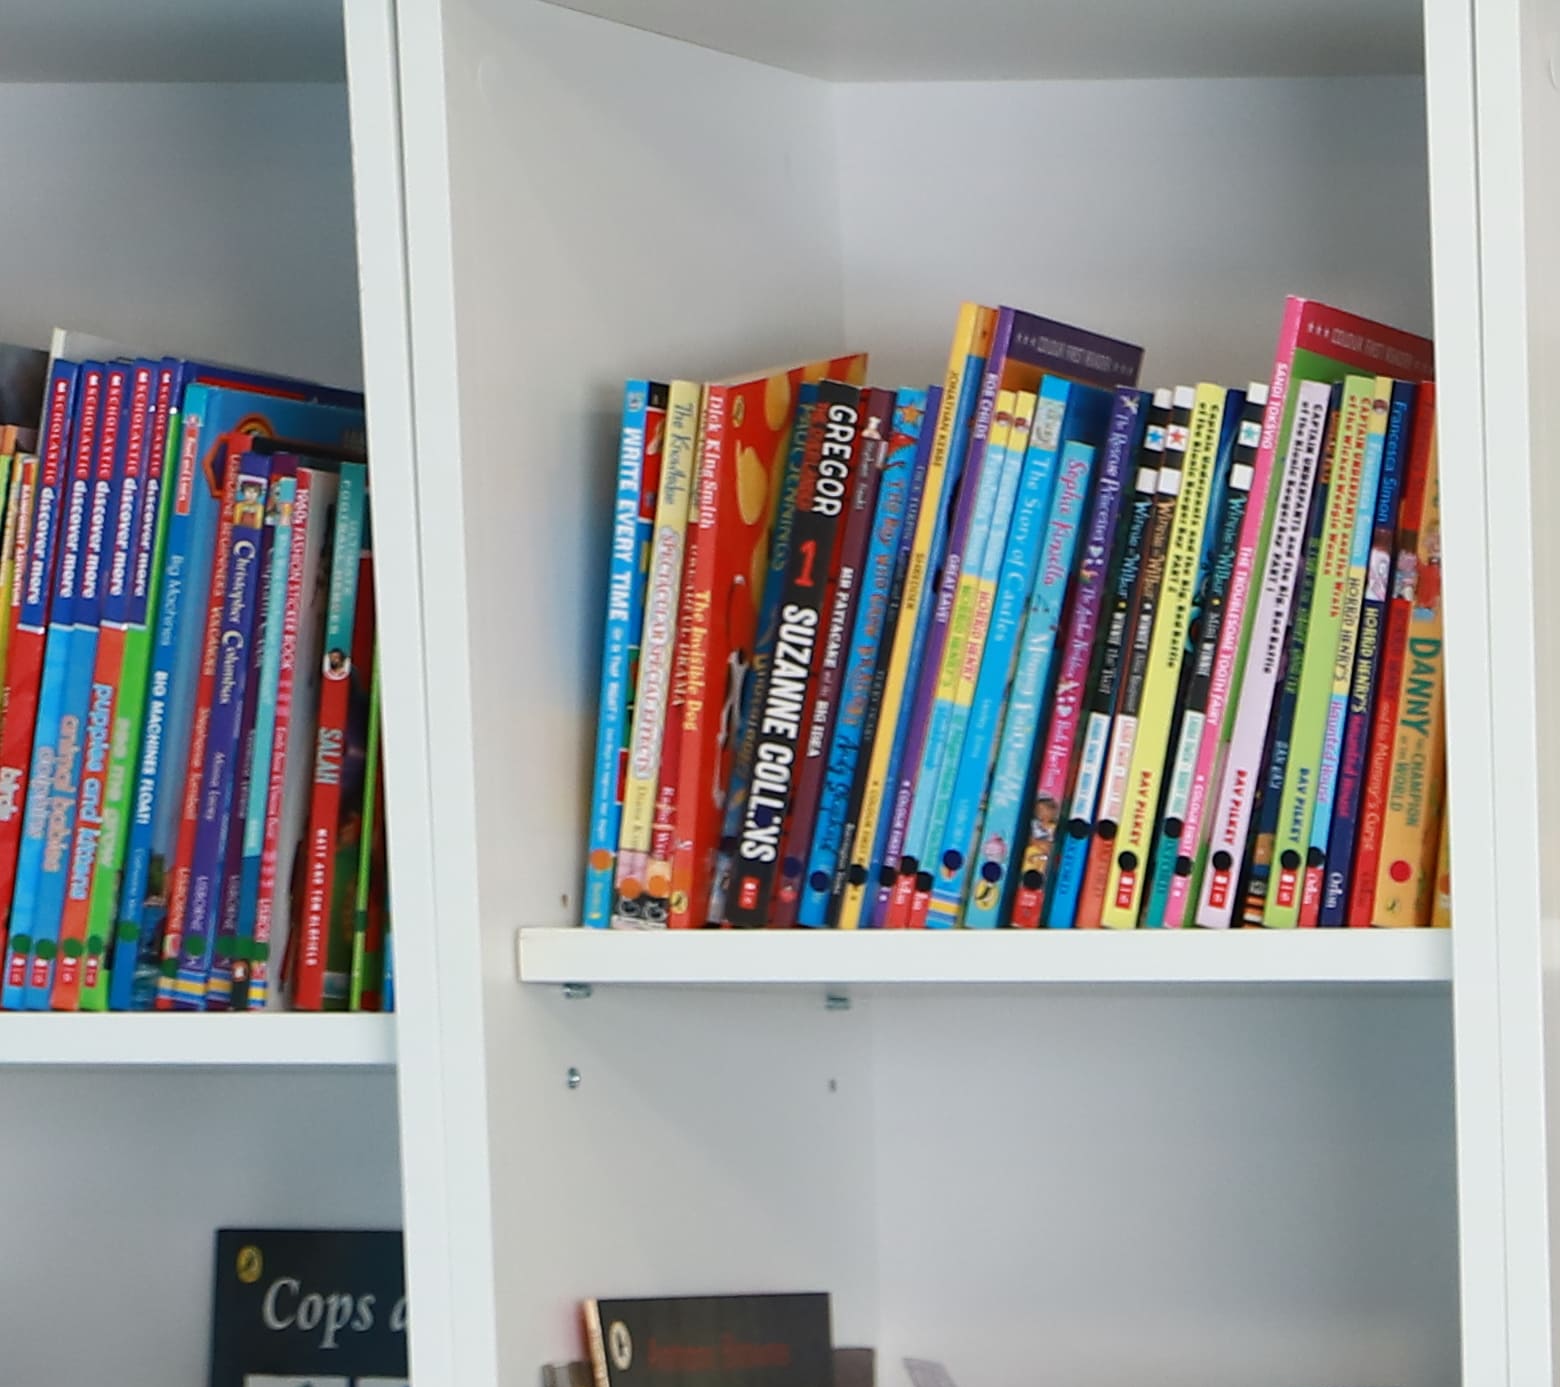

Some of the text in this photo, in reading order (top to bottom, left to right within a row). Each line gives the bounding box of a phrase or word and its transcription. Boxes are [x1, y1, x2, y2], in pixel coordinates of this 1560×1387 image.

[109, 384, 147, 596] SCHOLASTIC discover more
[609, 427, 642, 620] WRITE EVERY TIME
[809, 403, 857, 517] GREGOR
[1376, 400, 1408, 522] Francesca Simon
[994, 458, 1048, 642] The Story of Castles
[217, 540, 257, 704] Christopher Columbus
[683, 590, 711, 731] The Invisible Dog
[315, 727, 343, 784] SALAH
[739, 604, 818, 862] SUZANNE COLLNS
[1401, 637, 1441, 827] DANNY CHAMPION
[1129, 771, 1151, 846] DAV PILKEY
[1223, 771, 1247, 845] DAV PILKEY
[1288, 768, 1309, 844] DAV PILKEY
[262, 1276, 375, 1349] Cops
